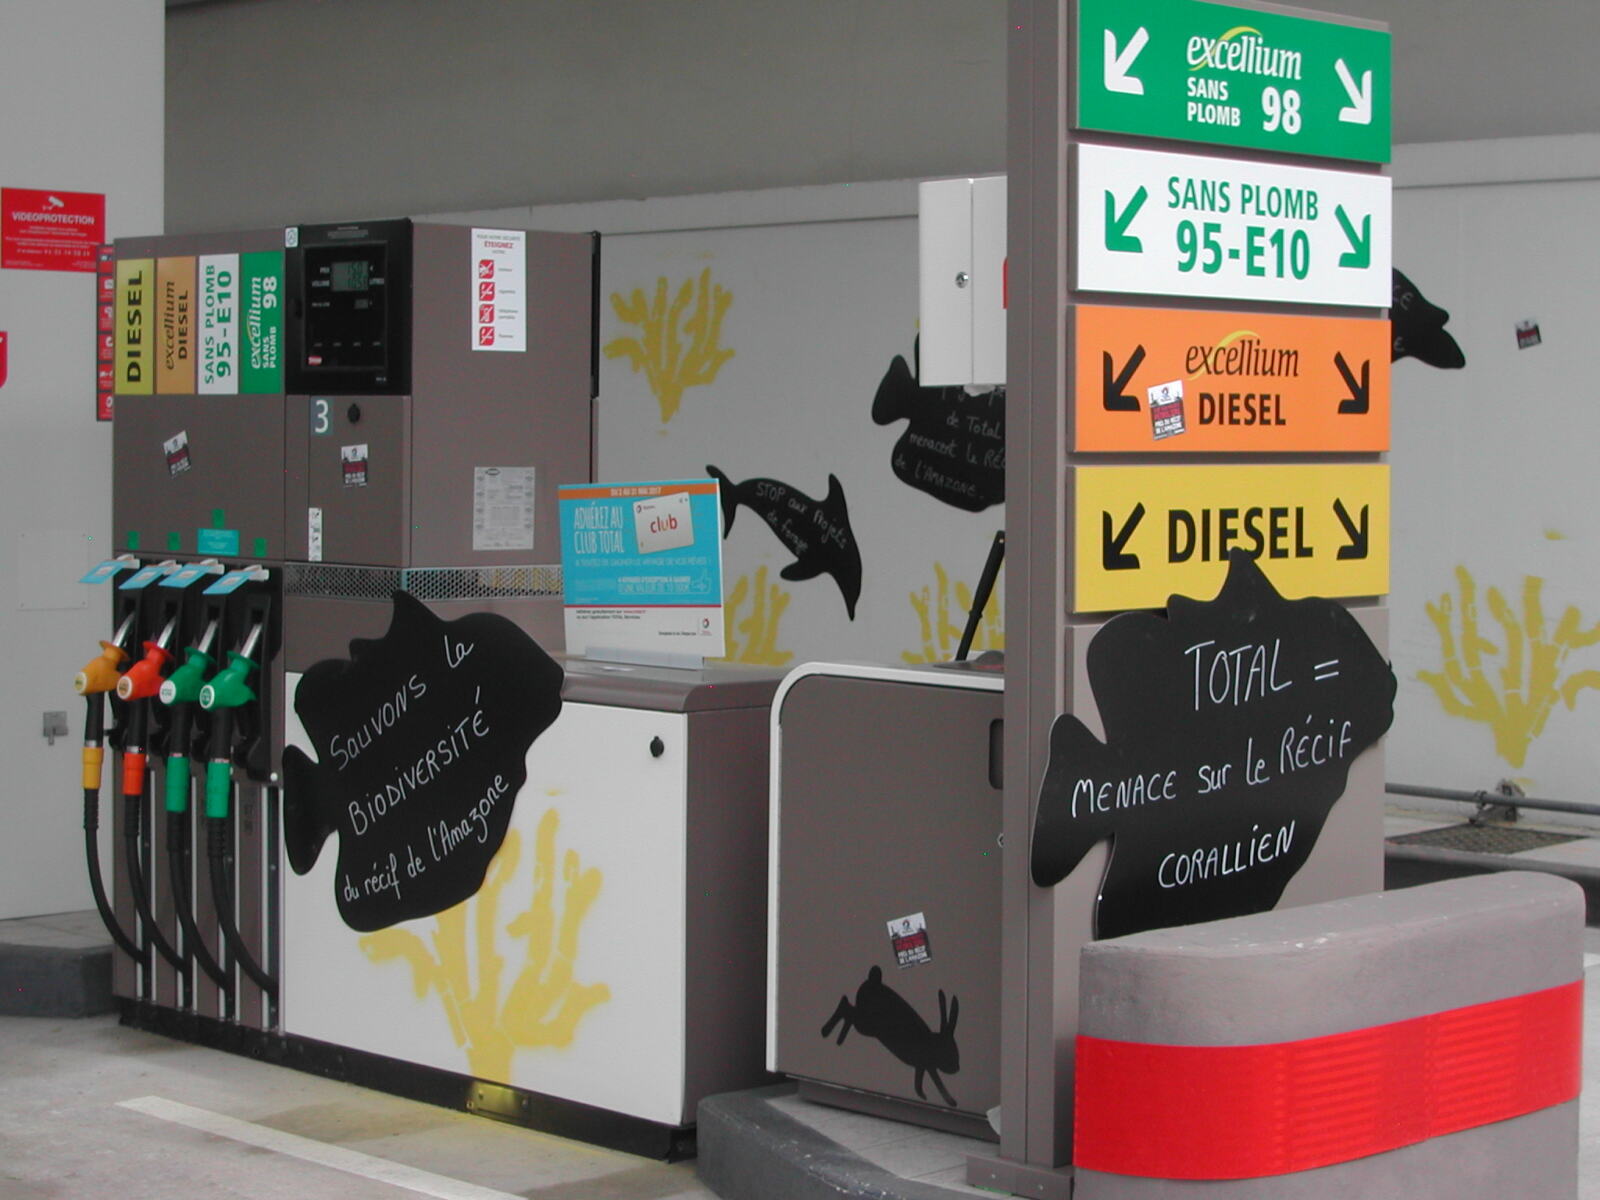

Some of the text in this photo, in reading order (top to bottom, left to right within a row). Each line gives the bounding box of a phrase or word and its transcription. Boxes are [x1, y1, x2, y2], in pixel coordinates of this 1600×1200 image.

[1186, 34, 1303, 81] excellium
[1187, 76, 1229, 101] SANS
[1261, 85, 1302, 135] 98
[1187, 101, 1241, 128] PLOMB
[12, 211, 95, 225] VIDEOPROTECTION
[1167, 175, 1319, 221] SANS PLOMB
[1176, 219, 1310, 281] 95-E10
[262, 276, 278, 309] 98
[127, 270, 143, 383] DIESEL
[163, 281, 175, 370] excellium
[178, 290, 189, 360] DIESEL
[205, 265, 216, 384] SANS PLOMB
[216, 271, 232, 378] 95-E10
[249, 276, 262, 369] excellium
[262, 336, 270, 368] SANS
[269, 326, 277, 368] PLOMB
[1185, 339, 1299, 378] excellium
[315, 399, 329, 433] 3
[966, 416, 1001, 440] Total
[1198, 392, 1287, 426] DIESEL
[574, 501, 624, 529] ADHÉREZ AU
[756, 482, 786, 503] STOP
[575, 530, 625, 554] CLUB TOTAL
[650, 513, 678, 534] club
[1168, 506, 1314, 564] DIESEL
[1184, 638, 1293, 711] TOTAL
[1071, 770, 1178, 819] MENACE
[344, 873, 360, 902] du
[364, 852, 401, 900] récif
[407, 844, 426, 878] de
[1157, 820, 1296, 889] CORALLIEN
